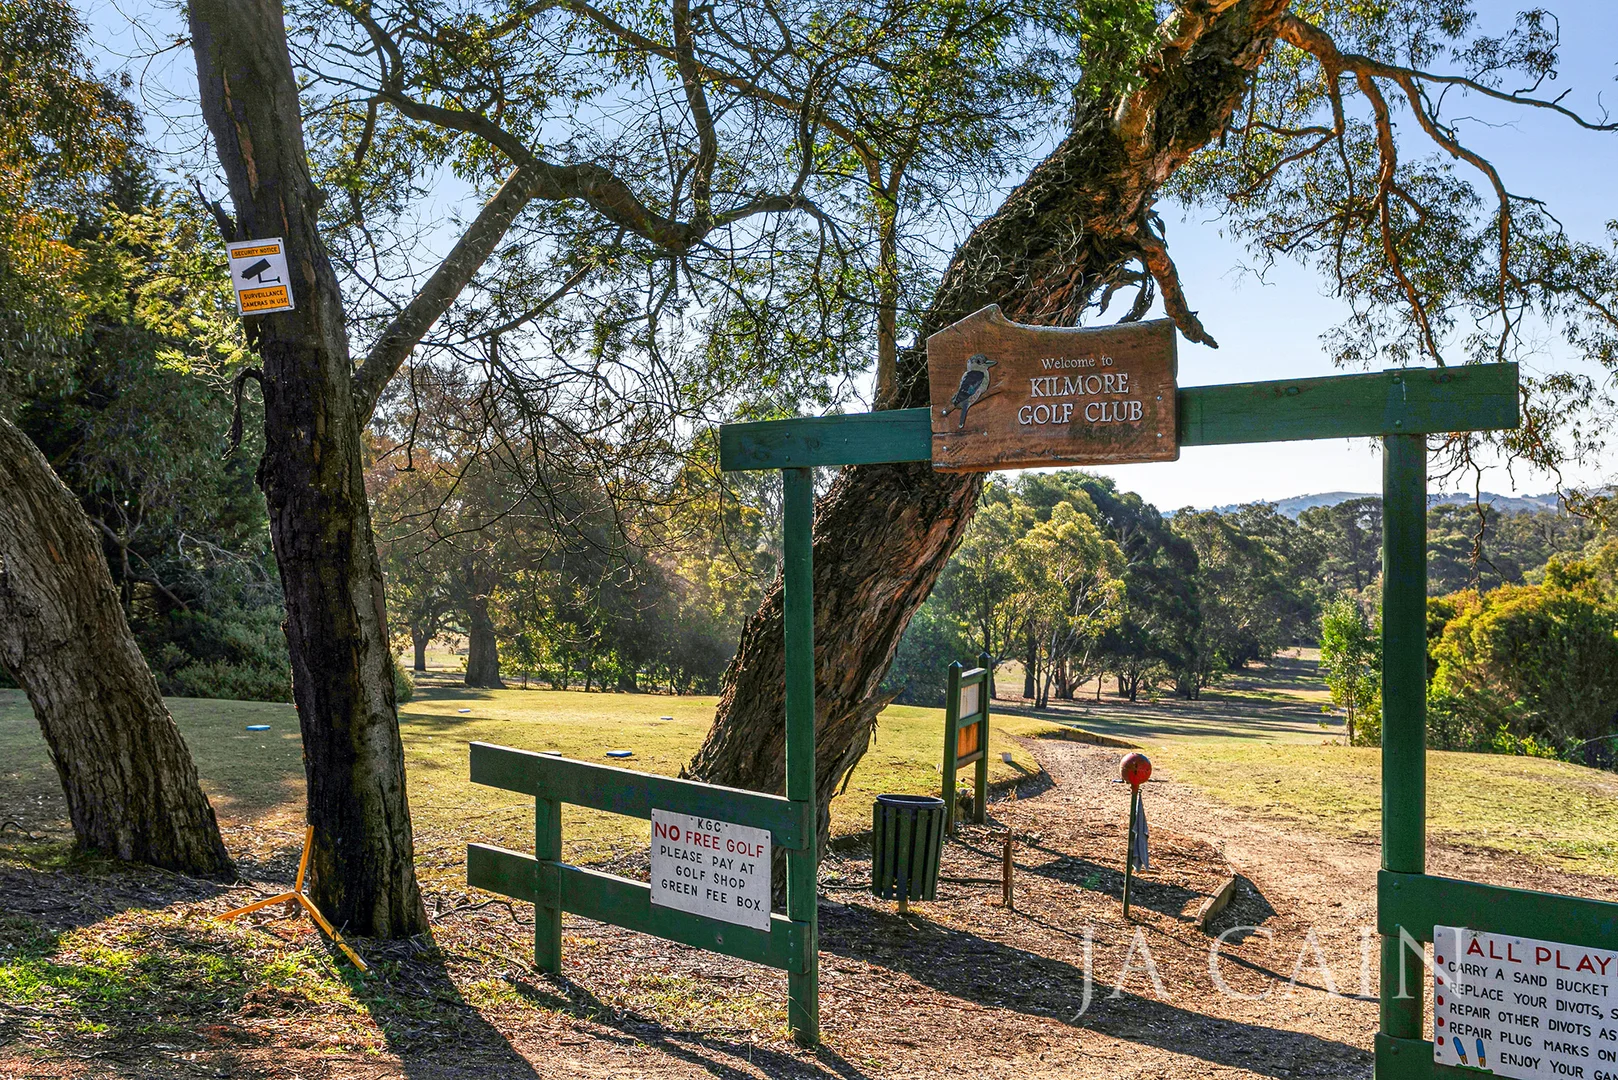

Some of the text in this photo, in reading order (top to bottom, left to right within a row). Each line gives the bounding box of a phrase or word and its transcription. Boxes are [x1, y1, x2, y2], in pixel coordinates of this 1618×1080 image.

[234, 249, 258, 257] SECURITY
[242, 299, 268, 307] CAMERAS
[243, 289, 284, 300] SURVEILLANCE
[1041, 355, 1113, 370] Welcome to
[1030, 373, 1129, 398] KILMORE
[1018, 400, 1143, 425] GOLF CLUB
[654, 821, 764, 858] NO FREE GOLF
[660, 845, 755, 875] PLEASE PAY AT
[675, 865, 746, 890] GOLF SHOP
[661, 878, 765, 912] GREEN FEE BOX.
[1466, 937, 1618, 977] ALL PLAY
[1448, 961, 1609, 997] CARRY A SAND BUCKET
[1449, 982, 1504, 1002] REPLACE
[1513, 992, 1548, 1009] YOUR
[1556, 999, 1604, 1020] DIVOTS,
[1449, 1002, 1618, 1041] REPAIR OTHER DIVOTS AS
[1449, 1021, 1617, 1063] REPAIR PLUG MARKS ON
[1500, 1052, 1541, 1070] ENJOY
[1549, 1059, 1584, 1079] YOUR
